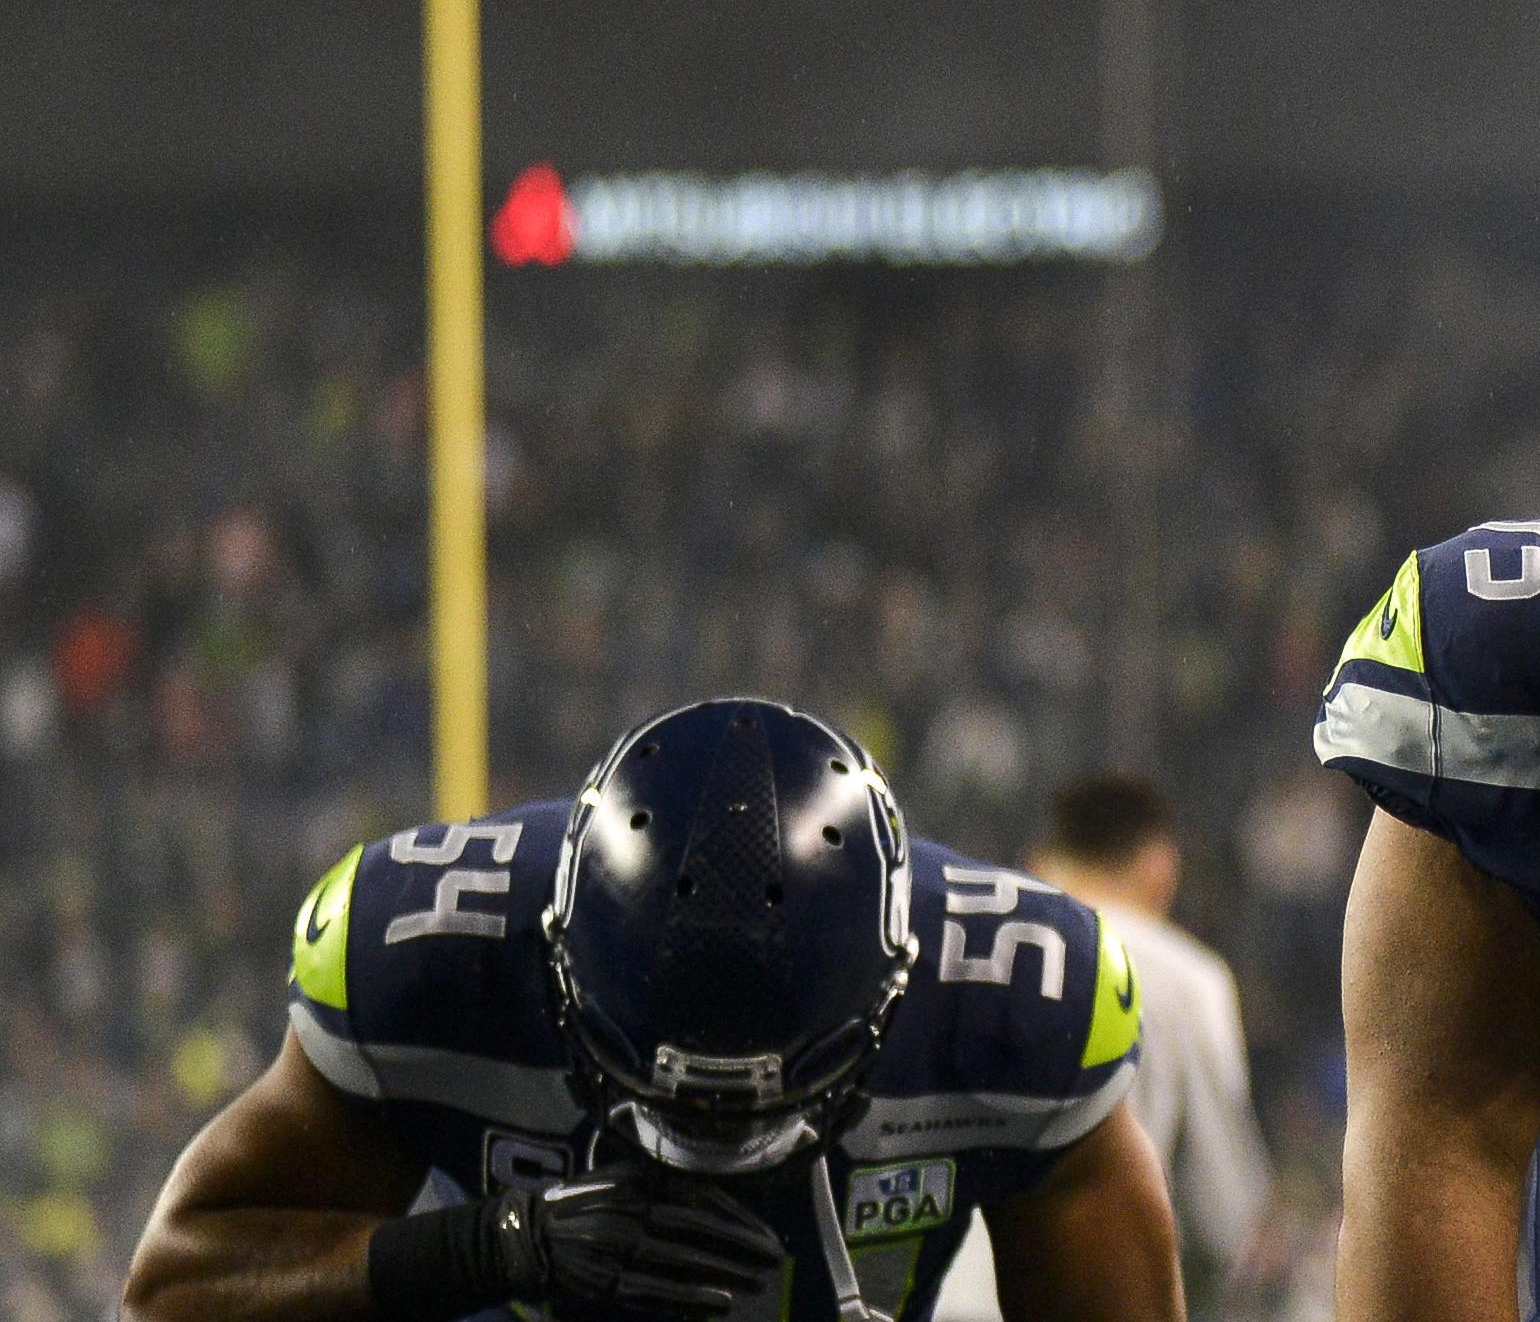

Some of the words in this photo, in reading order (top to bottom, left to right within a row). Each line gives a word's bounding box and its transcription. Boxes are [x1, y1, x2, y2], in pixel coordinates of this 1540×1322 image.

[384, 820, 525, 946] 54
[938, 863, 1067, 1001] 54
[855, 1193, 943, 1229] PGA
